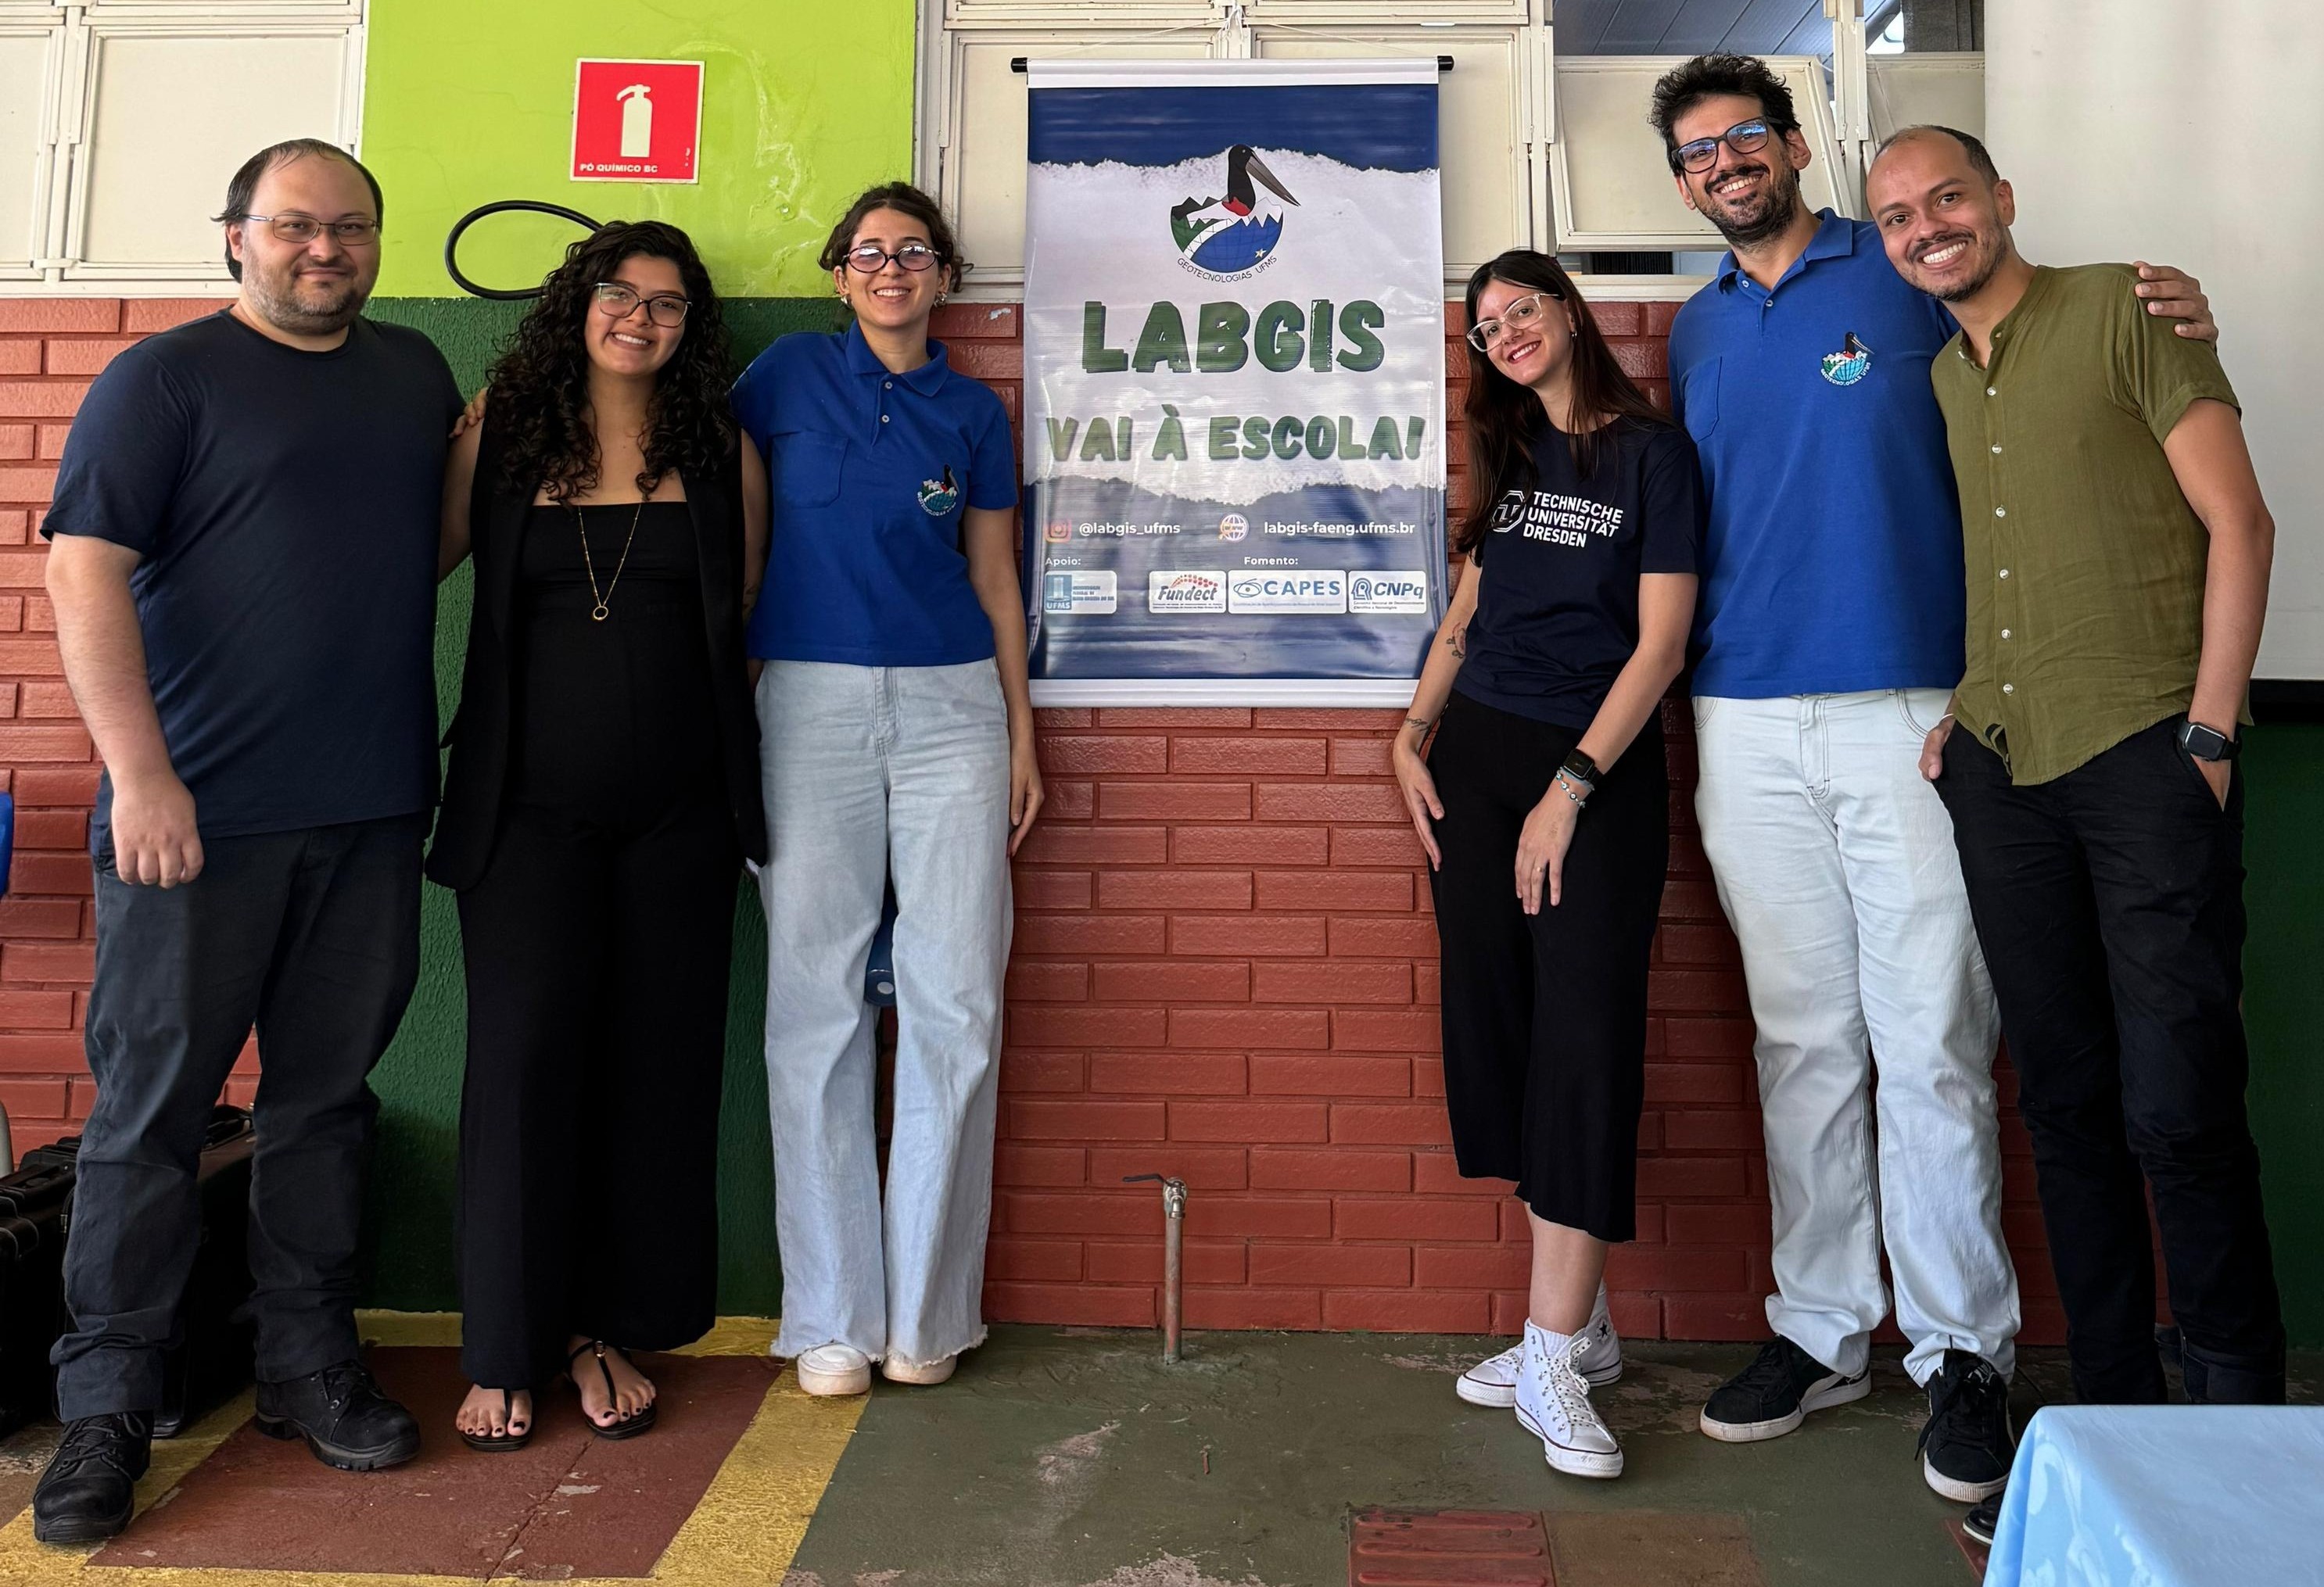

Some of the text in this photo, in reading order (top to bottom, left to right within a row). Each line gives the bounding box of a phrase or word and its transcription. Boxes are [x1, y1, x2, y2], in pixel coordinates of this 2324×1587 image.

[579, 162, 658, 173] PÓ QUÍMICO BC
[1177, 255, 1277, 282] GEOTECNOLOGIAS UFMS
[1081, 299, 1385, 373] LABGIS
[1046, 403, 1426, 461] VAI À ESCOLA!
[1533, 491, 1624, 525] TECHNISCHE
[1078, 521, 1181, 537] @labgis_ufms
[1264, 521, 1416, 536] labgis-faeng.ufms.br
[1527, 507, 1619, 538] UNIVERSITÄT
[1523, 523, 1587, 548] DRESDEN
[1045, 557, 1081, 567] Apoio:
[1244, 556, 1299, 565] Fomento:
[1157, 586, 1218, 601] Fundect
[1264, 580, 1341, 596] CAPES
[1374, 582, 1425, 600] CNPq
